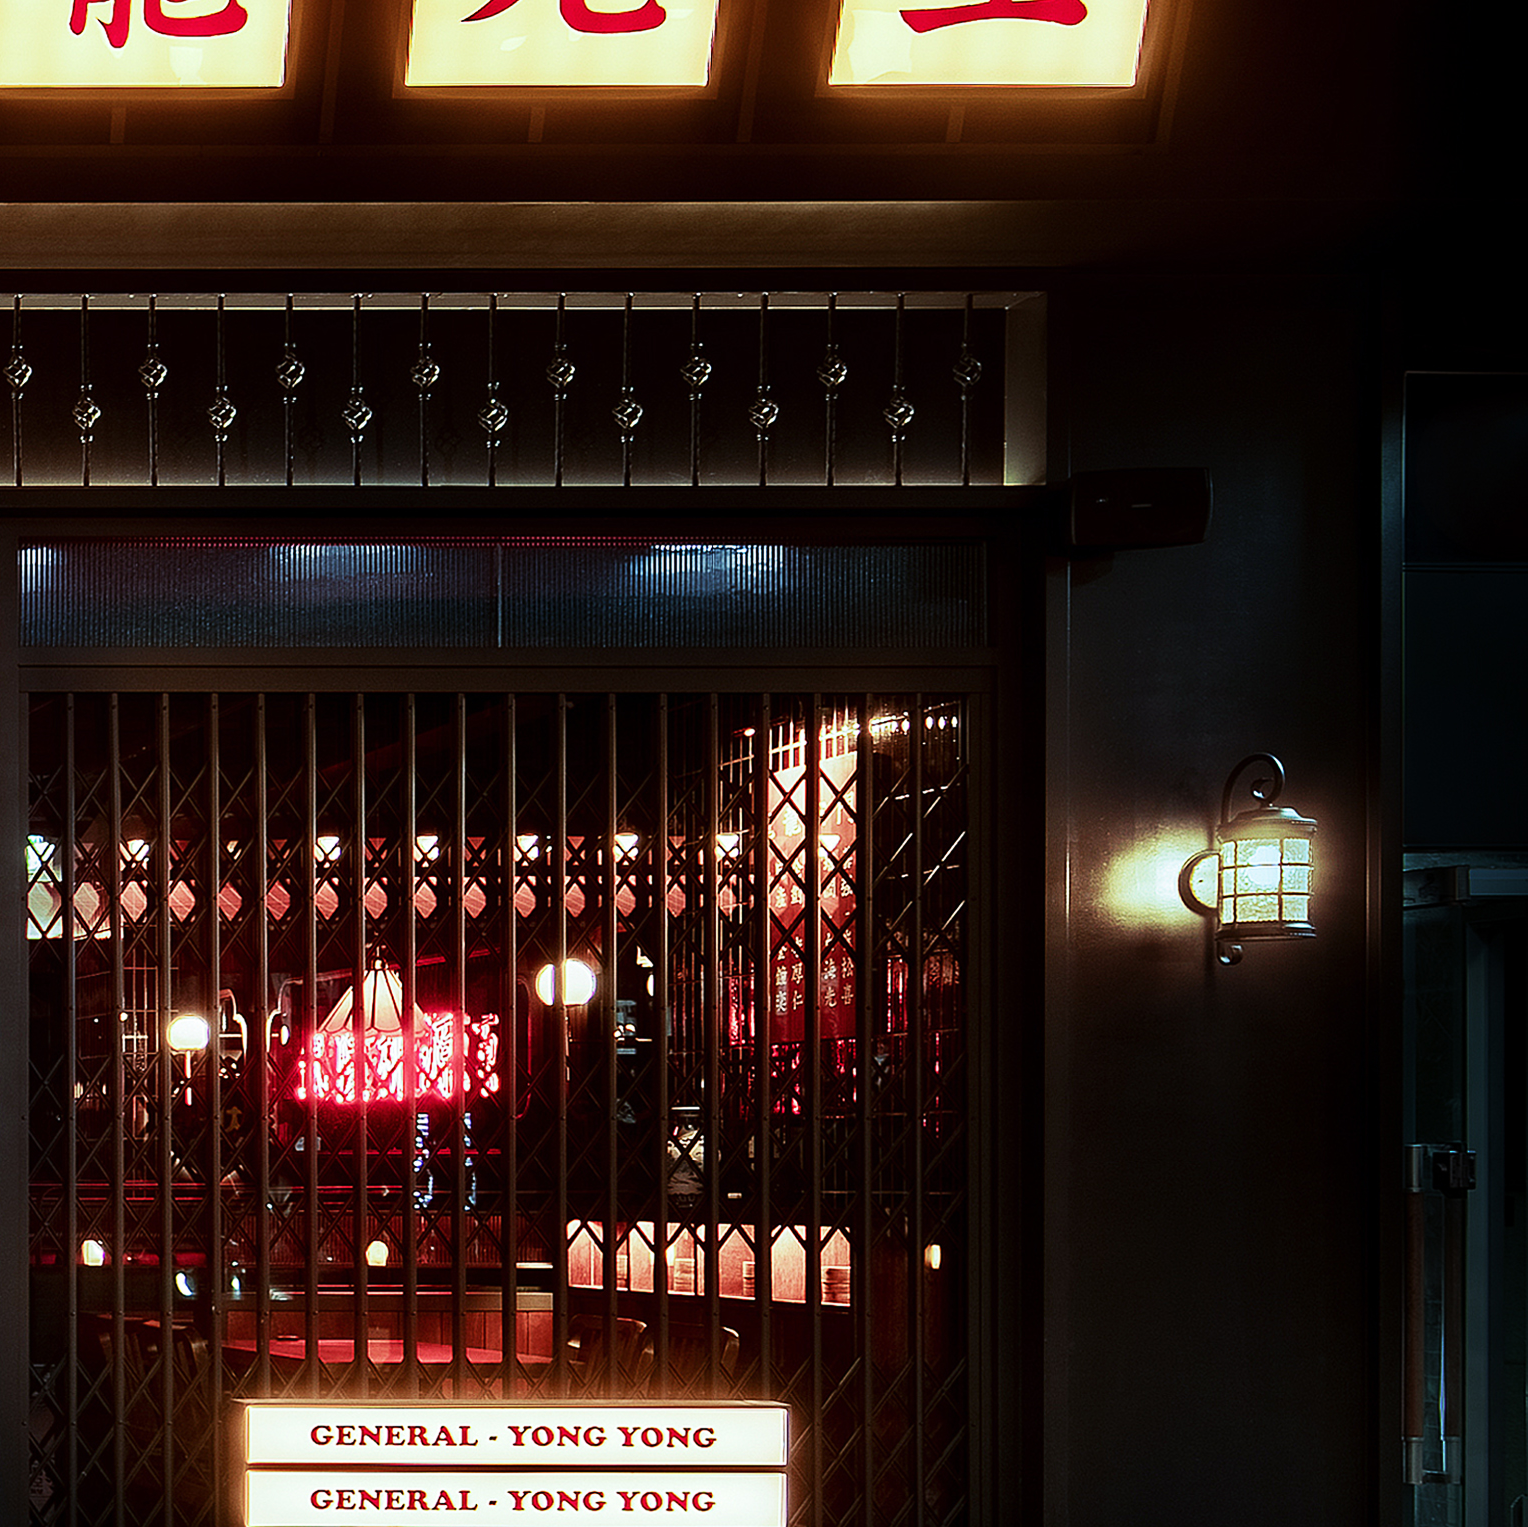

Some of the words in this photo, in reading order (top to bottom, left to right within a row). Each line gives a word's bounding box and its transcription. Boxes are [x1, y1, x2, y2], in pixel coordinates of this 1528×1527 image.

[310, 1425, 479, 1448] GENERAL
[508, 1425, 607, 1448] YONG
[617, 1426, 717, 1449] YONG
[310, 1489, 478, 1512] GENERAL
[508, 1490, 606, 1512] YONG
[617, 1491, 716, 1513] YONG
